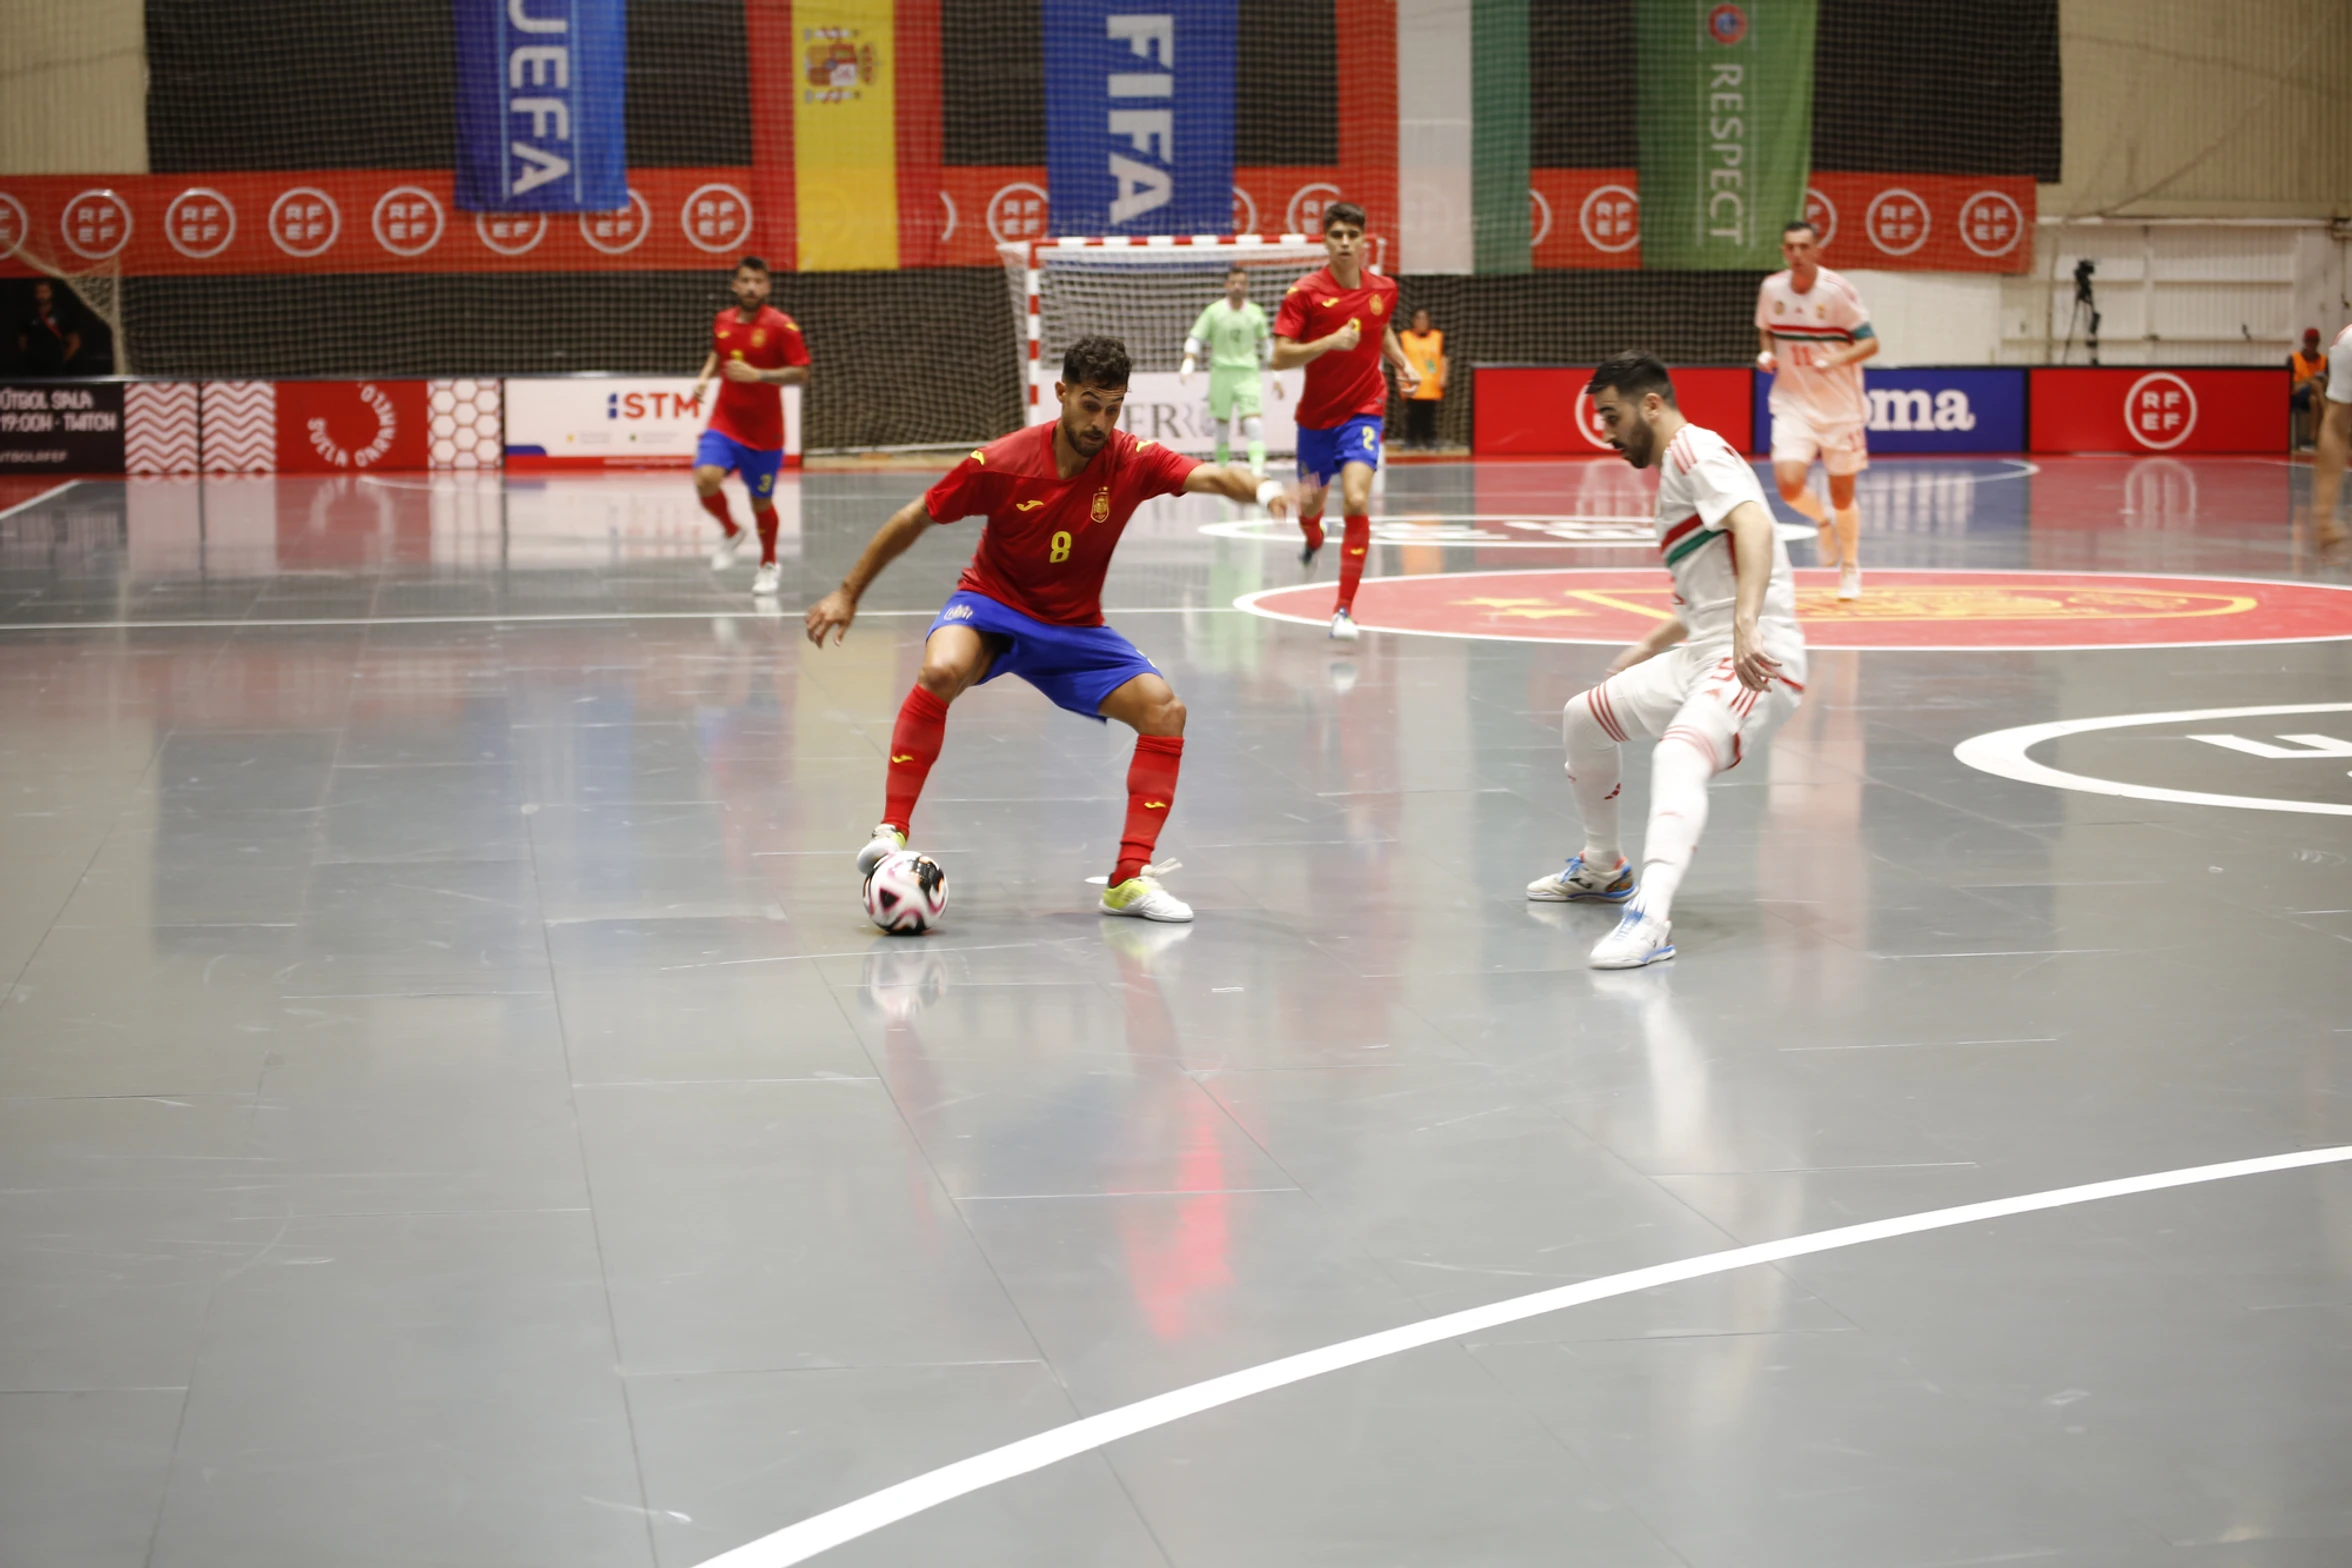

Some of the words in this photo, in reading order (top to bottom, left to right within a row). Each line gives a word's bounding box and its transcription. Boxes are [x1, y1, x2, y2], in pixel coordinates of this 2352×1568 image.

[508, 0, 570, 196] UEFA
[1107, 14, 1174, 225] FIFA
[1709, 63, 1744, 246] RESPECT
[0, 387, 48, 410] ÚTBOL
[51, 391, 94, 410] SALA
[1864, 389, 1977, 431] ma
[2141, 391, 2181, 409] RF
[2141, 412, 2181, 430] EF
[1362, 426, 1375, 450] 2
[758, 474, 773, 493] 3
[1049, 531, 1072, 563] 8
